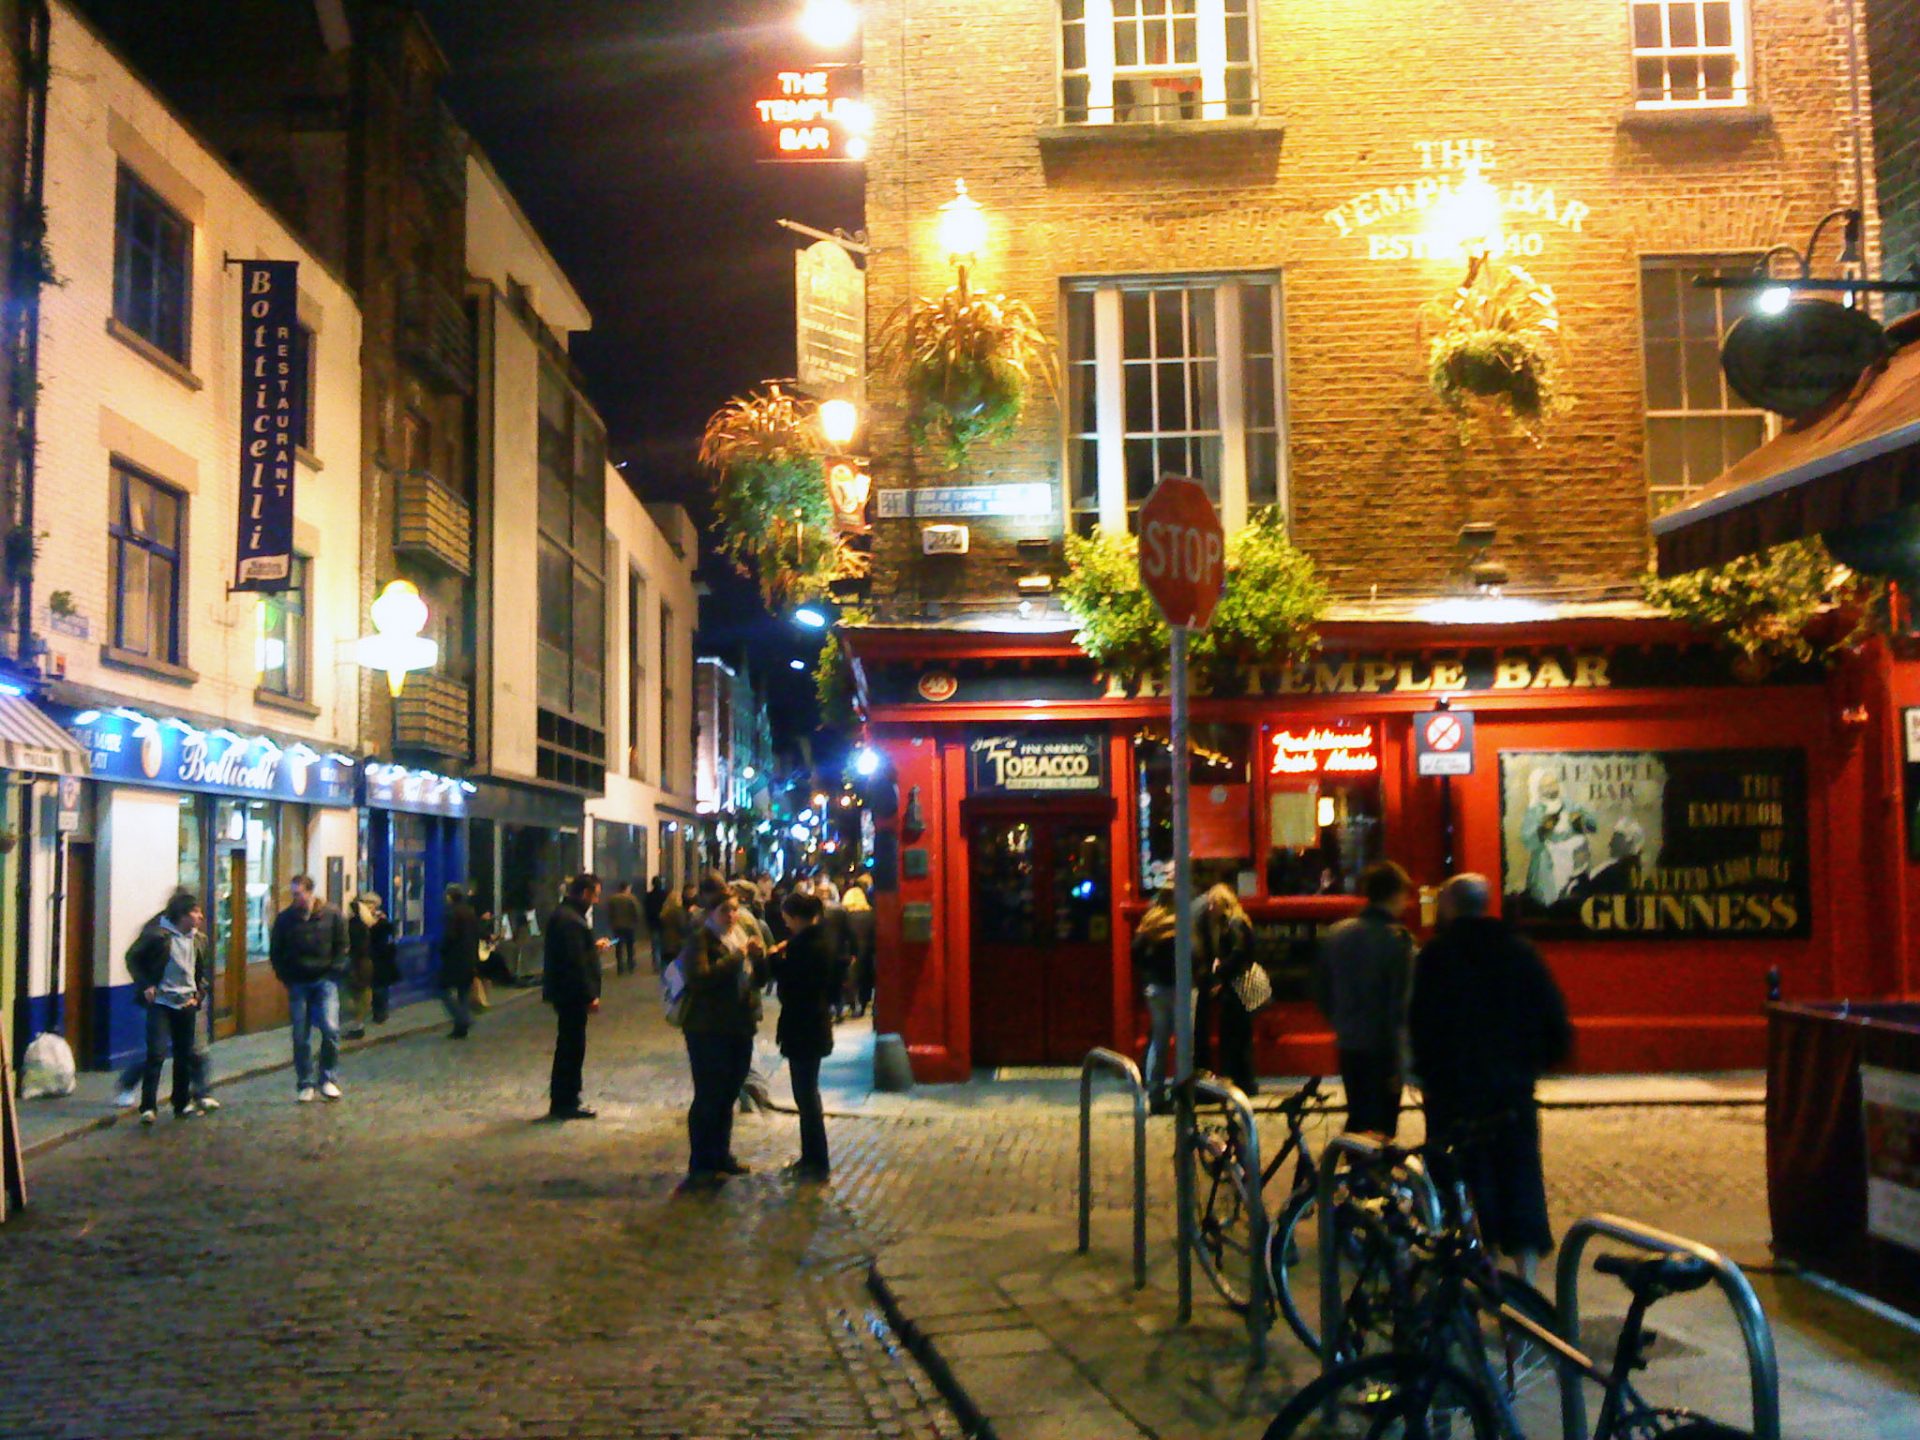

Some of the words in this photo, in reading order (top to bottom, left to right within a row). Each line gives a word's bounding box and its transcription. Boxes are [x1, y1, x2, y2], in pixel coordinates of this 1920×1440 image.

[778, 72, 829, 95] THE
[780, 127, 830, 151] BAR
[1413, 138, 1497, 169] THE
[1510, 181, 1591, 233] BAR
[249, 270, 272, 549] Botticelli
[274, 326, 291, 498] RESTAURANT
[1146, 520, 1221, 585] STOP
[1240, 659, 1467, 695] TEMPLE
[1493, 656, 1611, 690] BAR
[1272, 726, 1373, 752] Traditional
[986, 749, 1089, 786] TOBACCO
[1557, 763, 1656, 782] TEMPLE
[1581, 894, 1798, 930] GUINNESS
